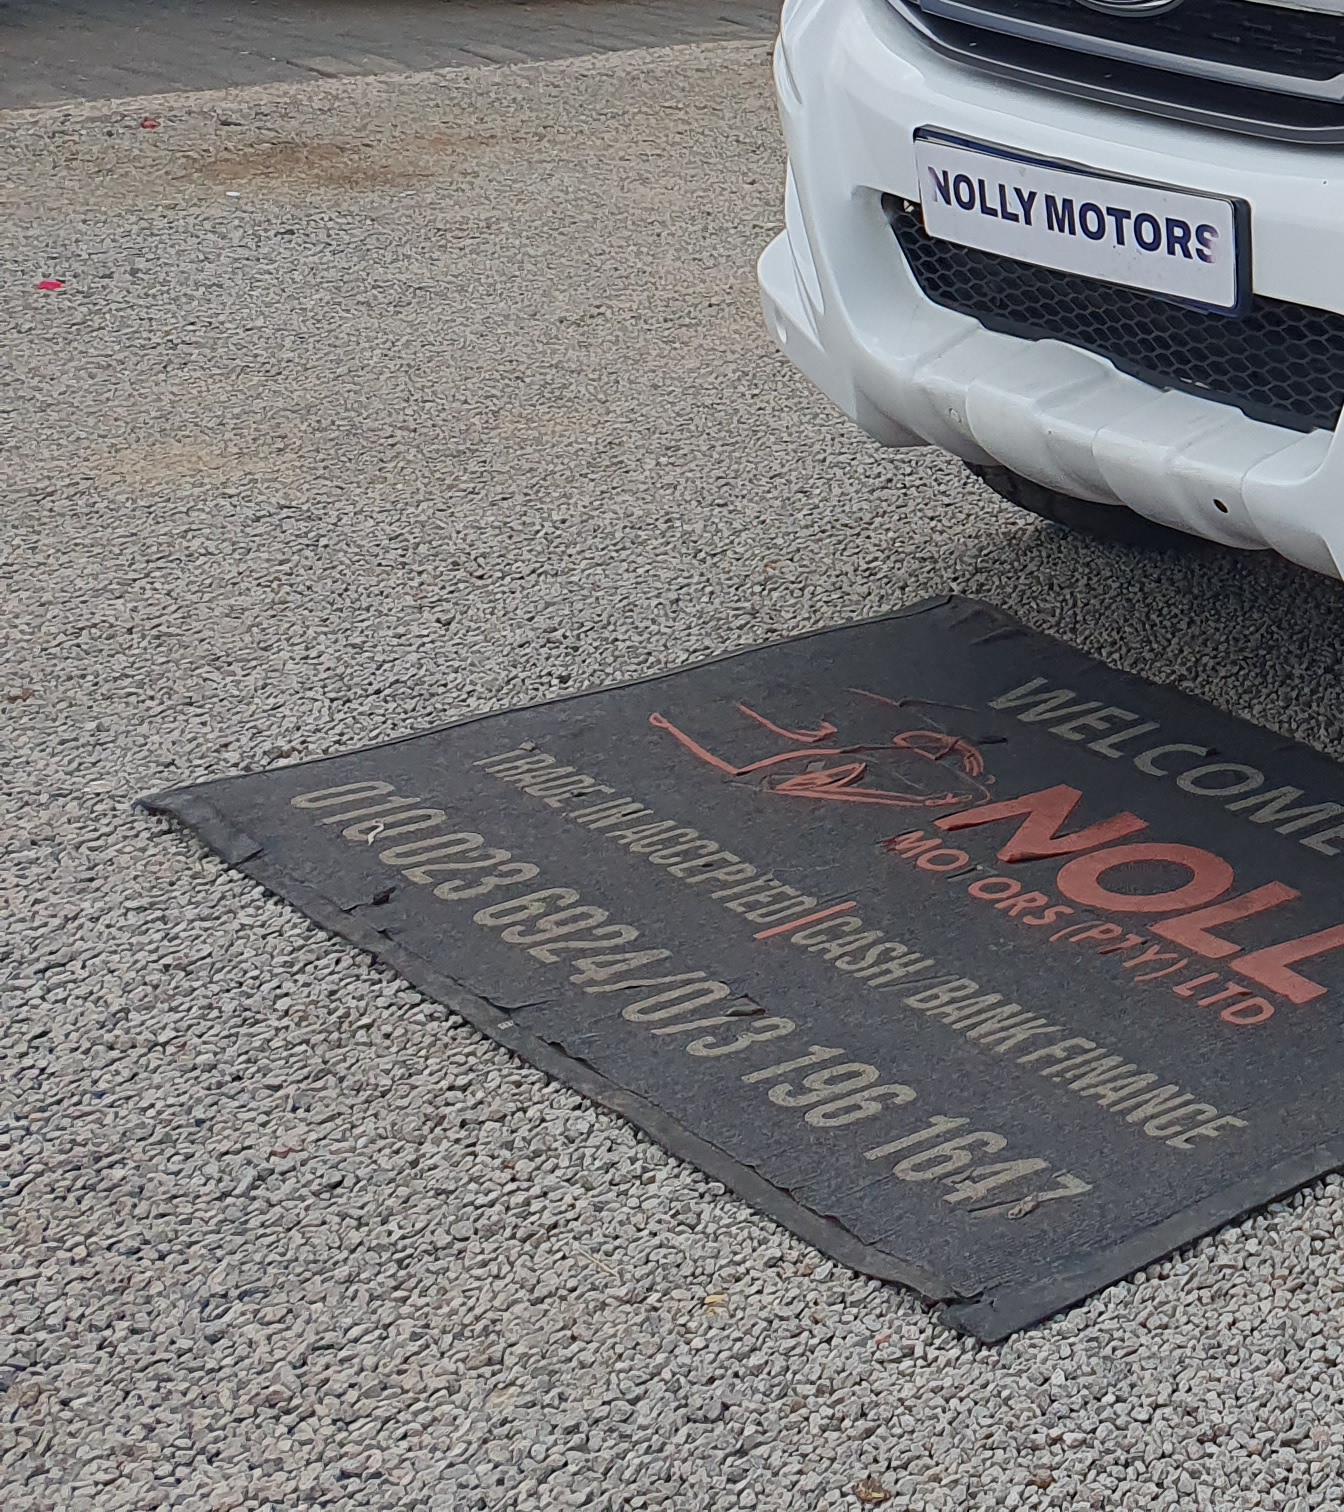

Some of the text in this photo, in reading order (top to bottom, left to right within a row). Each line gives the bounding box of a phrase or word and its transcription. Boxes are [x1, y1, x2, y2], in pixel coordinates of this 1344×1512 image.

[927, 165, 1220, 265] NOLLY MOTORS
[472, 742, 616, 808] TRADE
[567, 796, 654, 830] IN
[605, 819, 818, 924] ACCEPTED
[884, 830, 1275, 1026] MOTORS (PTY) LTD
[290, 780, 447, 843] 010
[378, 831, 541, 901] 023
[741, 1044, 917, 1128] 196
[864, 1113, 1094, 1217] 1647
[1016, 1036, 1249, 1150] FINANCE
